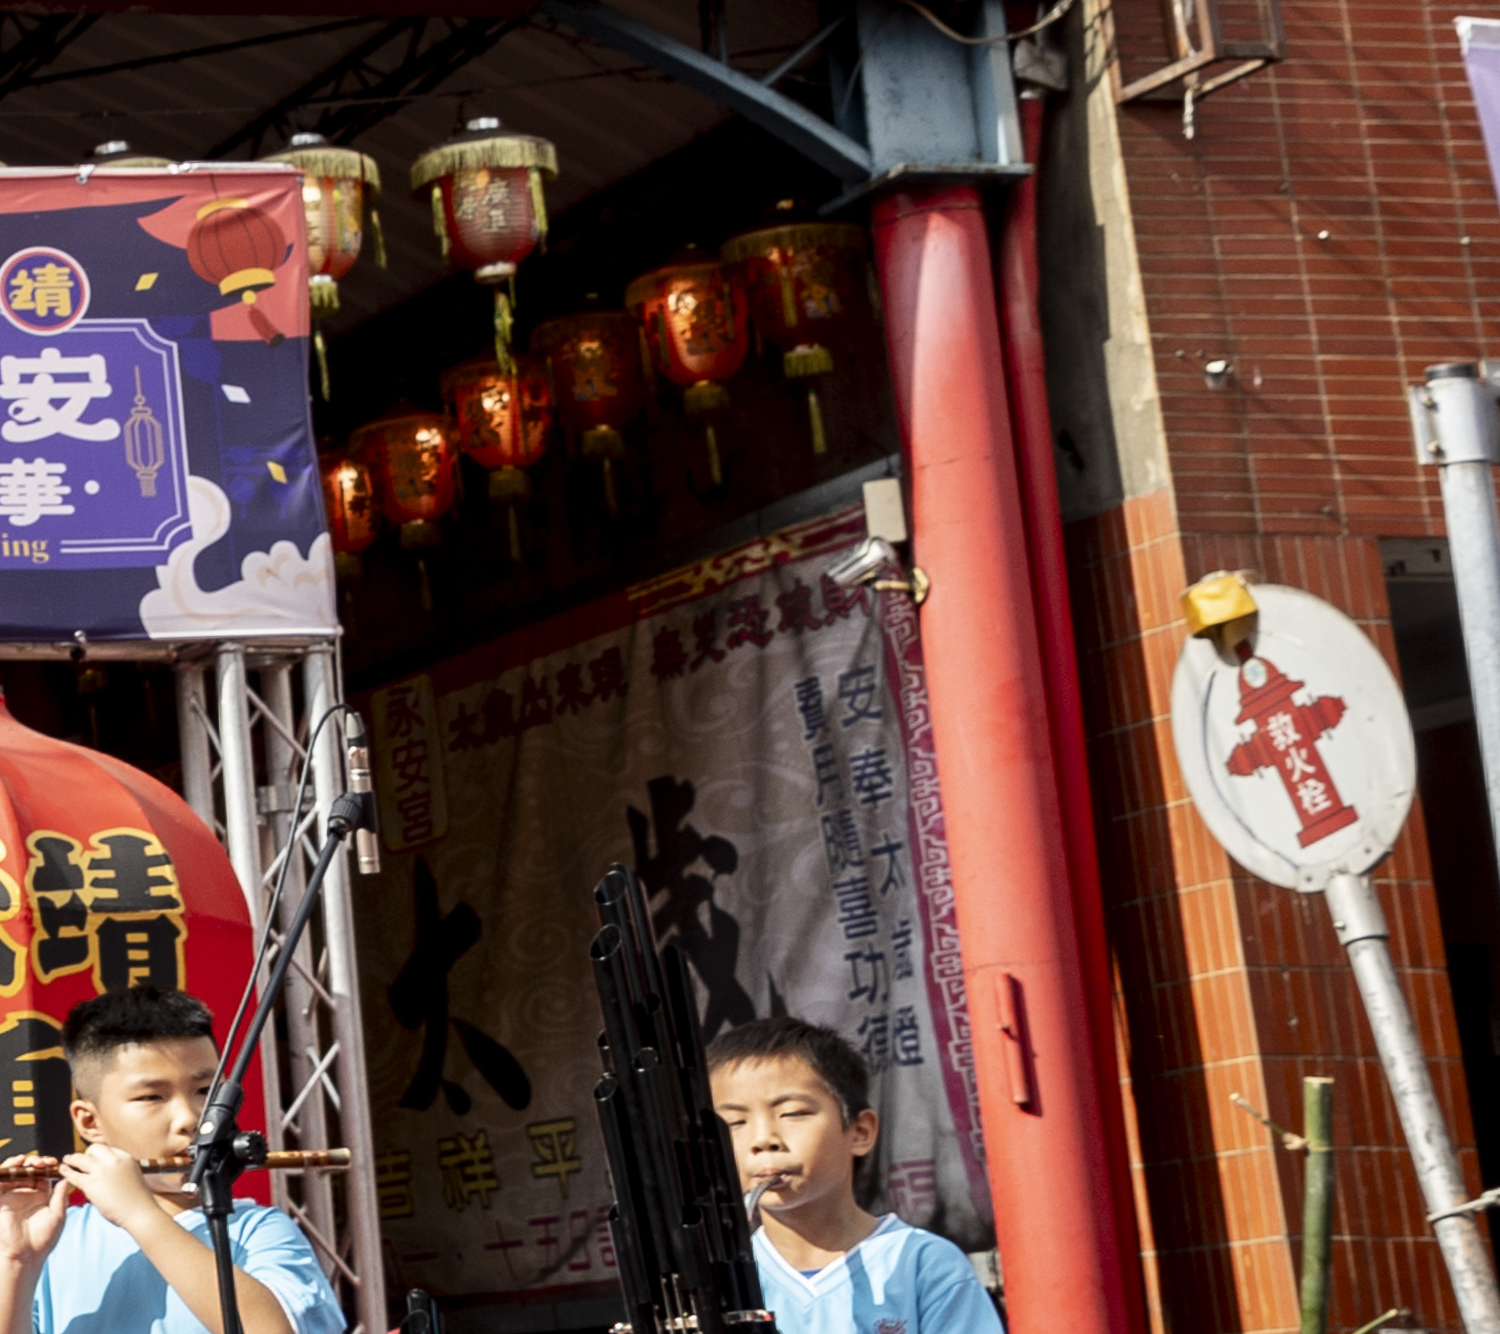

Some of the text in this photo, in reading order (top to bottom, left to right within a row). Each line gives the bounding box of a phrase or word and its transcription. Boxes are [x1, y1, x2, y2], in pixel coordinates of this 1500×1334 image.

[8, 262, 77, 319] 靖
[1266, 711, 1333, 816] 救火栓
